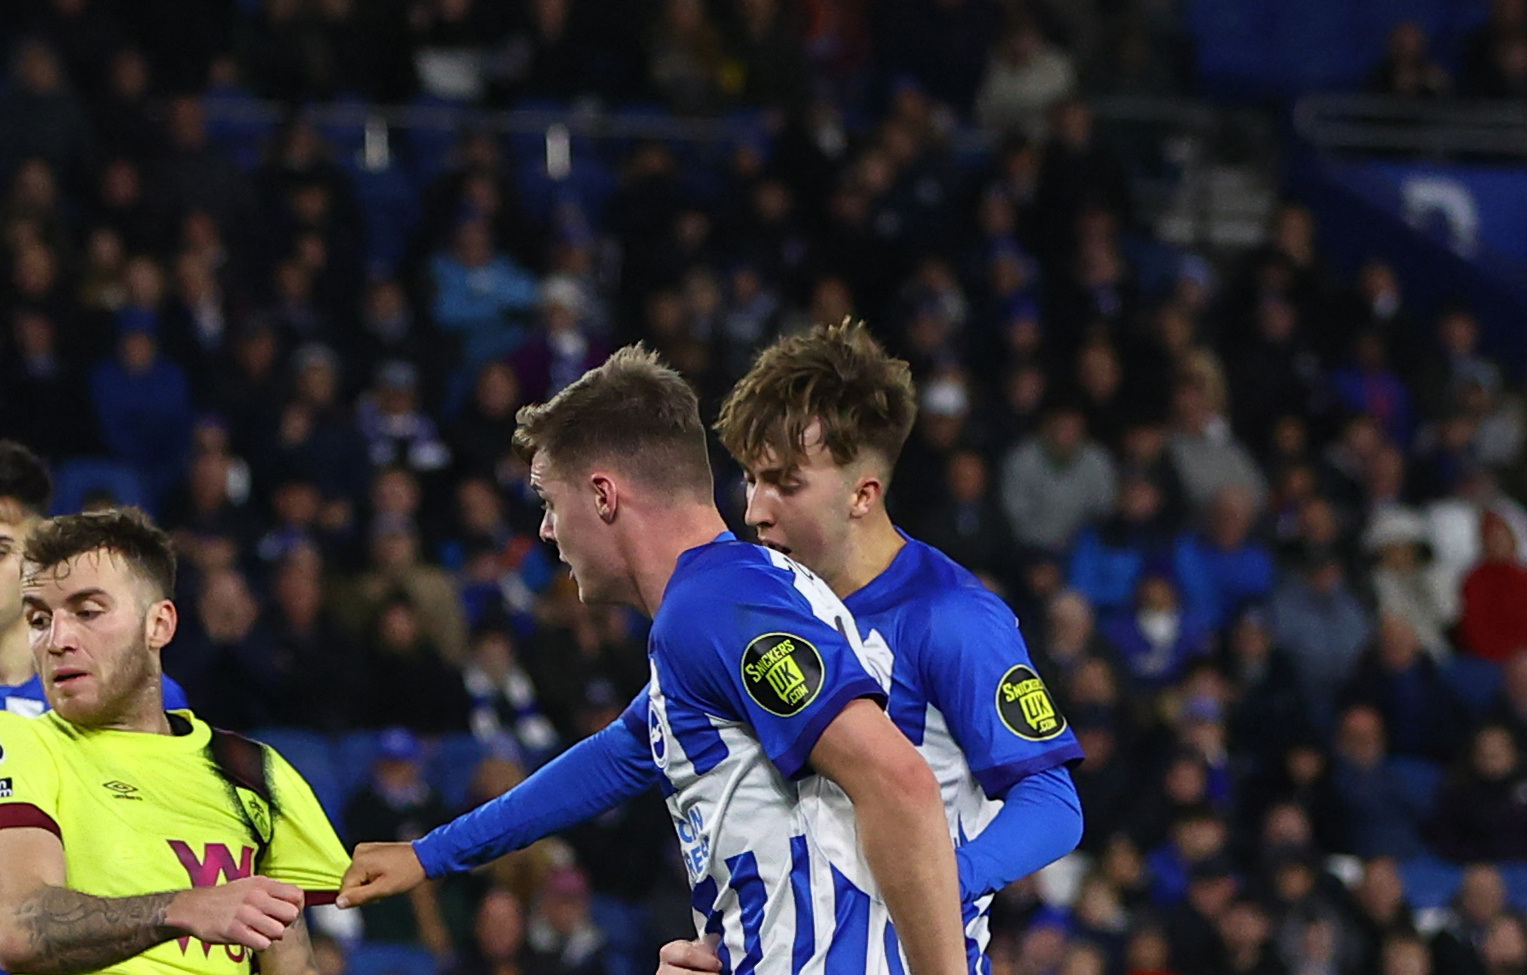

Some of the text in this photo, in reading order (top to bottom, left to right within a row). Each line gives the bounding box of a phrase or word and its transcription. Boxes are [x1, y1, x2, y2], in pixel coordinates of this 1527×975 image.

[744, 639, 795, 683] SNICKERS
[768, 661, 799, 695] UK
[1024, 693, 1051, 720] UK
